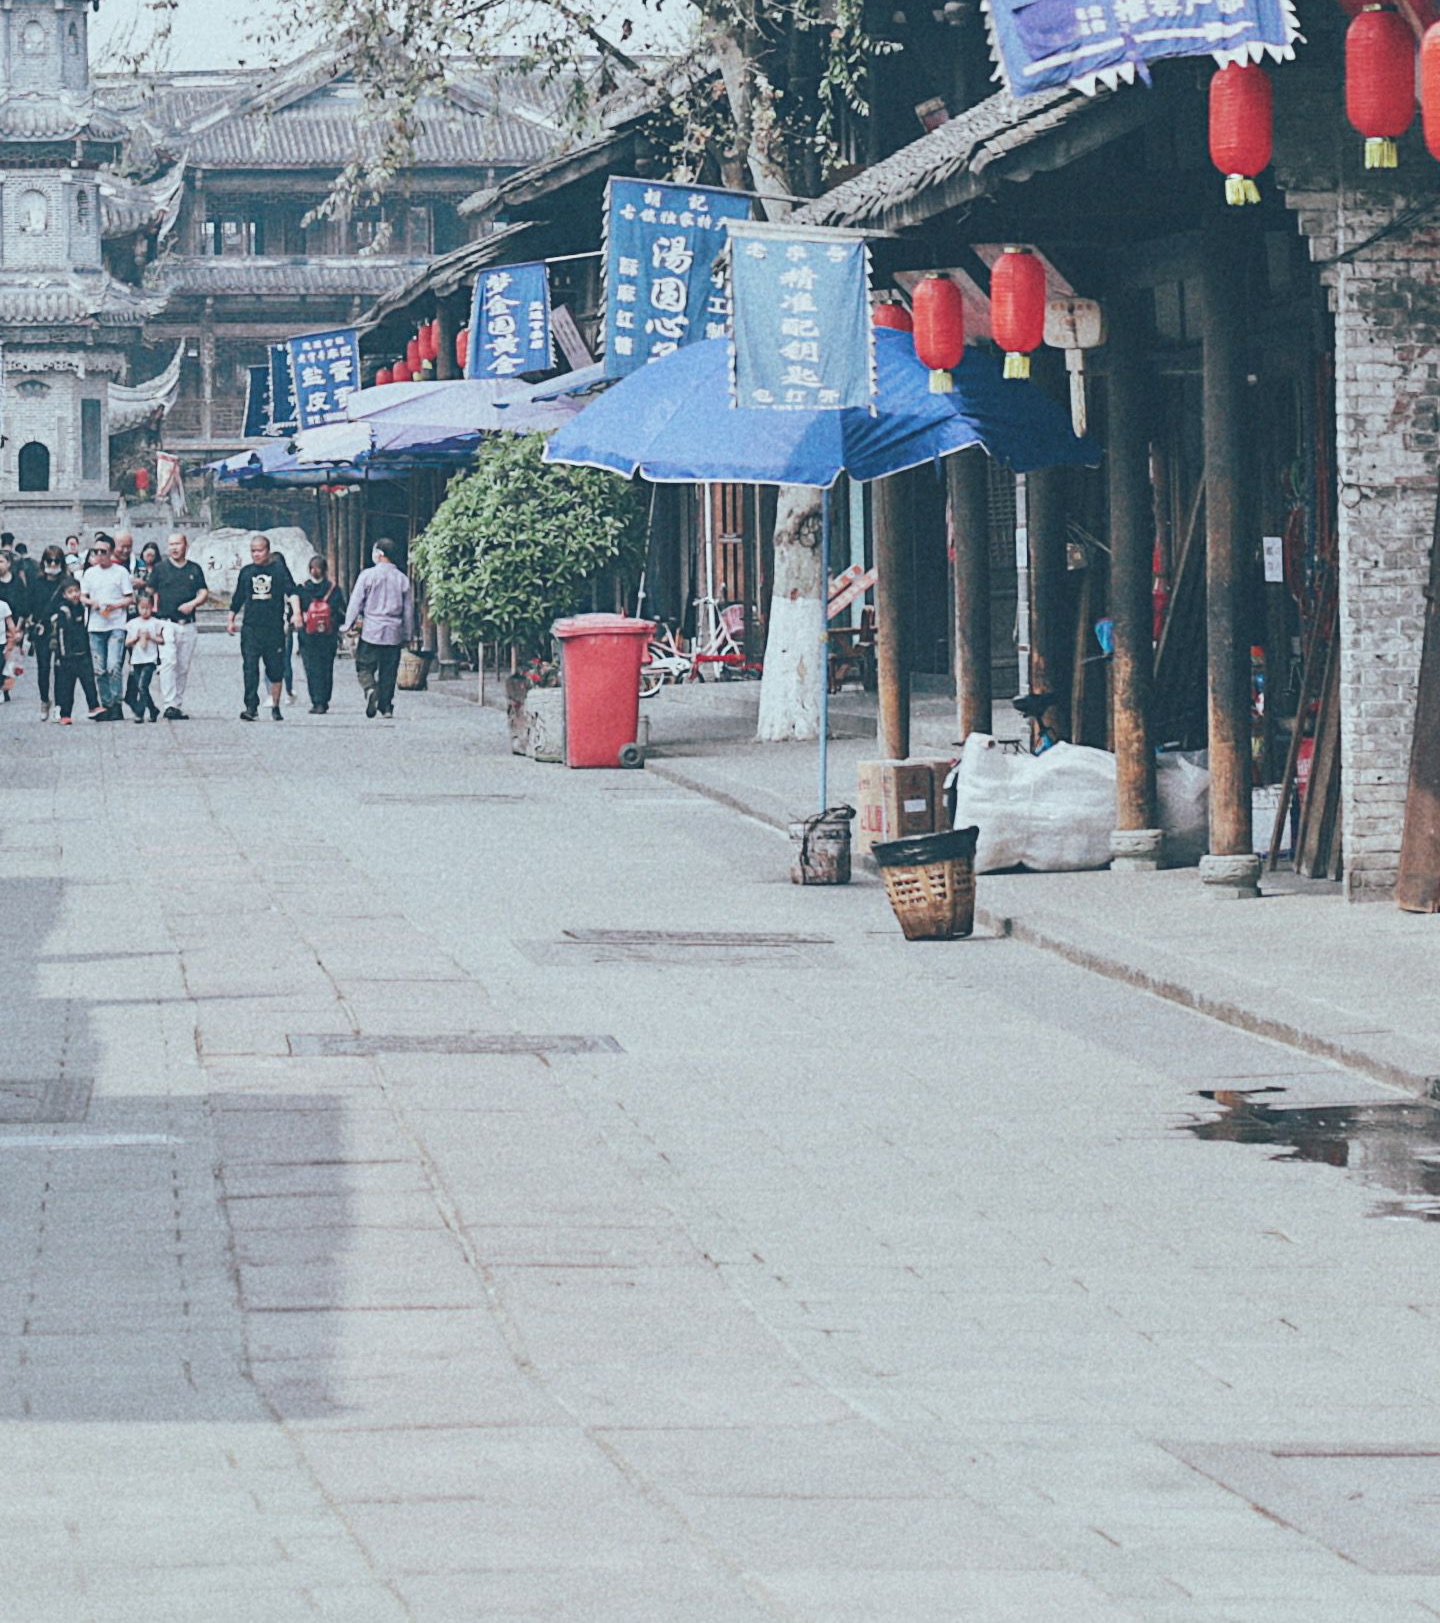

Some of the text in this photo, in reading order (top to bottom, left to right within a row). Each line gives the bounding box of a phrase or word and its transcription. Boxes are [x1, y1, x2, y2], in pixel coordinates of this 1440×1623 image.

[779, 265, 825, 388] 精准配钥匙
